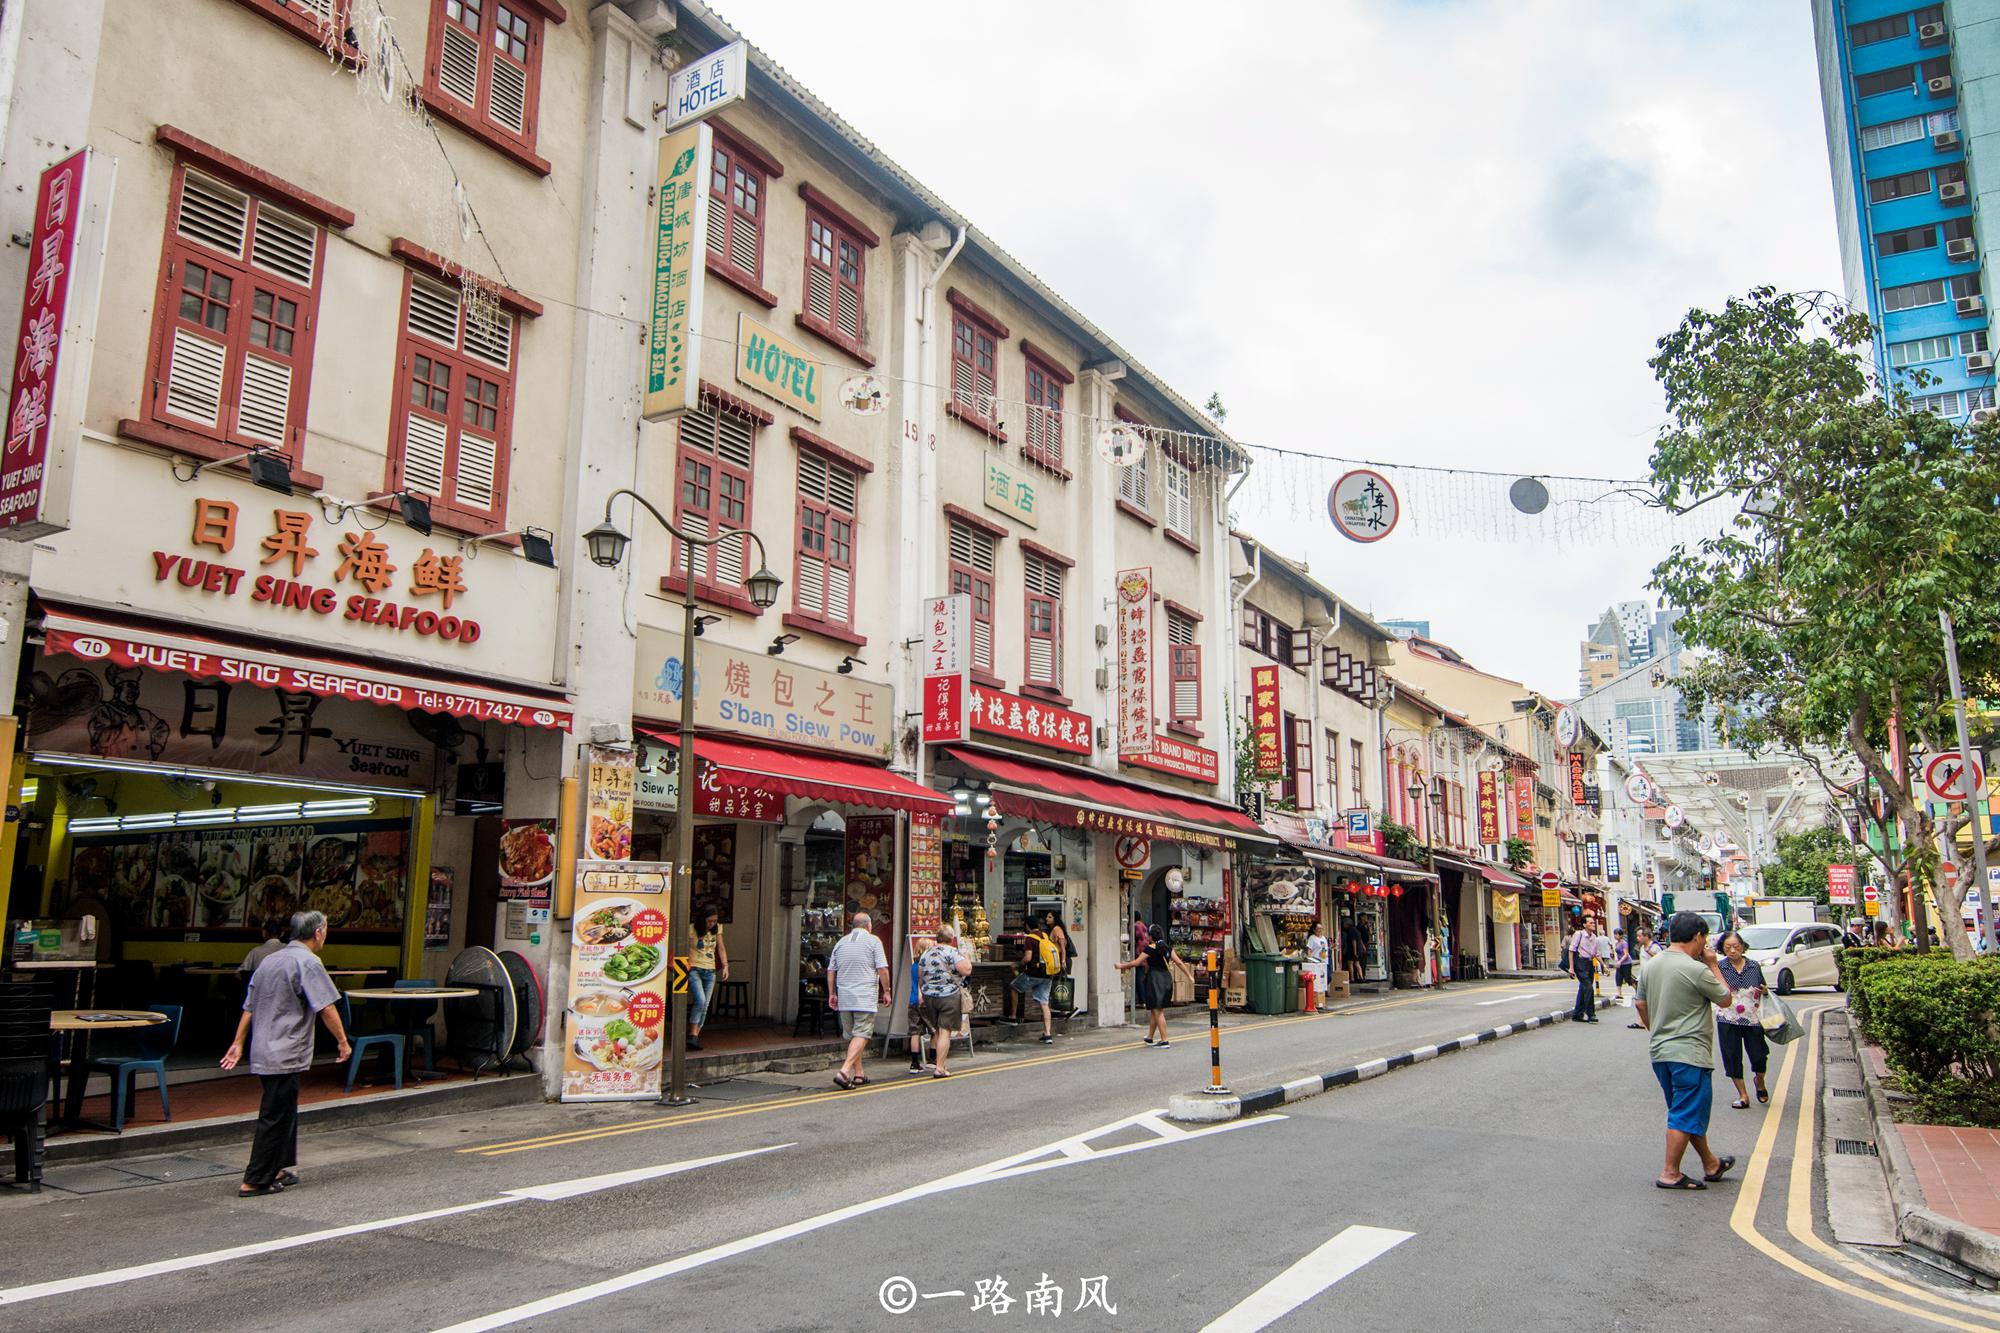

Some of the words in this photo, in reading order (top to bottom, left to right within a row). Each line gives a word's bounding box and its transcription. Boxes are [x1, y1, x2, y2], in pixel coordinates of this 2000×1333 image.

[685, 58, 725, 92] 酒店
[678, 78, 728, 117] HOTEL
[660, 183, 676, 228] HOTEL
[658, 229, 673, 269] POINT
[668, 180, 693, 320] 唐城坊酒店
[653, 271, 671, 349] CHINATOWN
[651, 351, 666, 377] YES
[746, 332, 816, 405] HOTEL
[904, 419, 936, 451] 198
[1, 468, 23, 491] YUET
[22, 462, 43, 485] SING
[990, 466, 1035, 513] 酒店
[0, 488, 38, 516] SEAFOOD
[152, 551, 246, 595] YUET
[251, 575, 338, 615] SING
[343, 595, 481, 644] SEAFOOD
[81, 640, 103, 654] 70
[931, 600, 948, 671] 燒包之王
[127, 643, 207, 672] YUET
[291, 669, 403, 702] SEAFOOD
[724, 657, 875, 726] 燒包之王
[415, 690, 443, 708] Tel:
[445, 696, 482, 715] 9771
[485, 701, 524, 721] 7427
[538, 712, 551, 723] 70
[179, 678, 334, 765] 日昇
[719, 699, 776, 728] S'ban
[785, 711, 830, 738] Siew
[839, 724, 876, 747] Pow
[335, 737, 384, 757] YUET
[385, 745, 422, 763] SING
[791, 731, 810, 744] FOOD
[810, 735, 835, 748] TRADING
[349, 755, 410, 778] Seafood
[1161, 742, 1181, 757] BRAND
[1183, 747, 1201, 763] BIRD'S
[1202, 753, 1215, 767] NEST
[1164, 758, 1185, 770] PRODUCTS
[1185, 764, 1201, 775] PRIVATE
[1201, 768, 1215, 778] LIMITED
[1260, 751, 1278, 759] TAM
[1260, 759, 1278, 767] KAH
[592, 767, 621, 789] 日昇
[641, 780, 665, 795] Siew
[667, 784, 679, 796] Po
[655, 801, 676, 809] TRADING
[708, 797, 764, 818] 甜品茶室
[257, 824, 316, 842] SEAFOOD
[608, 874, 641, 891] 日昇
[678, 864, 685, 876] 4
[591, 1071, 632, 1082] 无服务费
